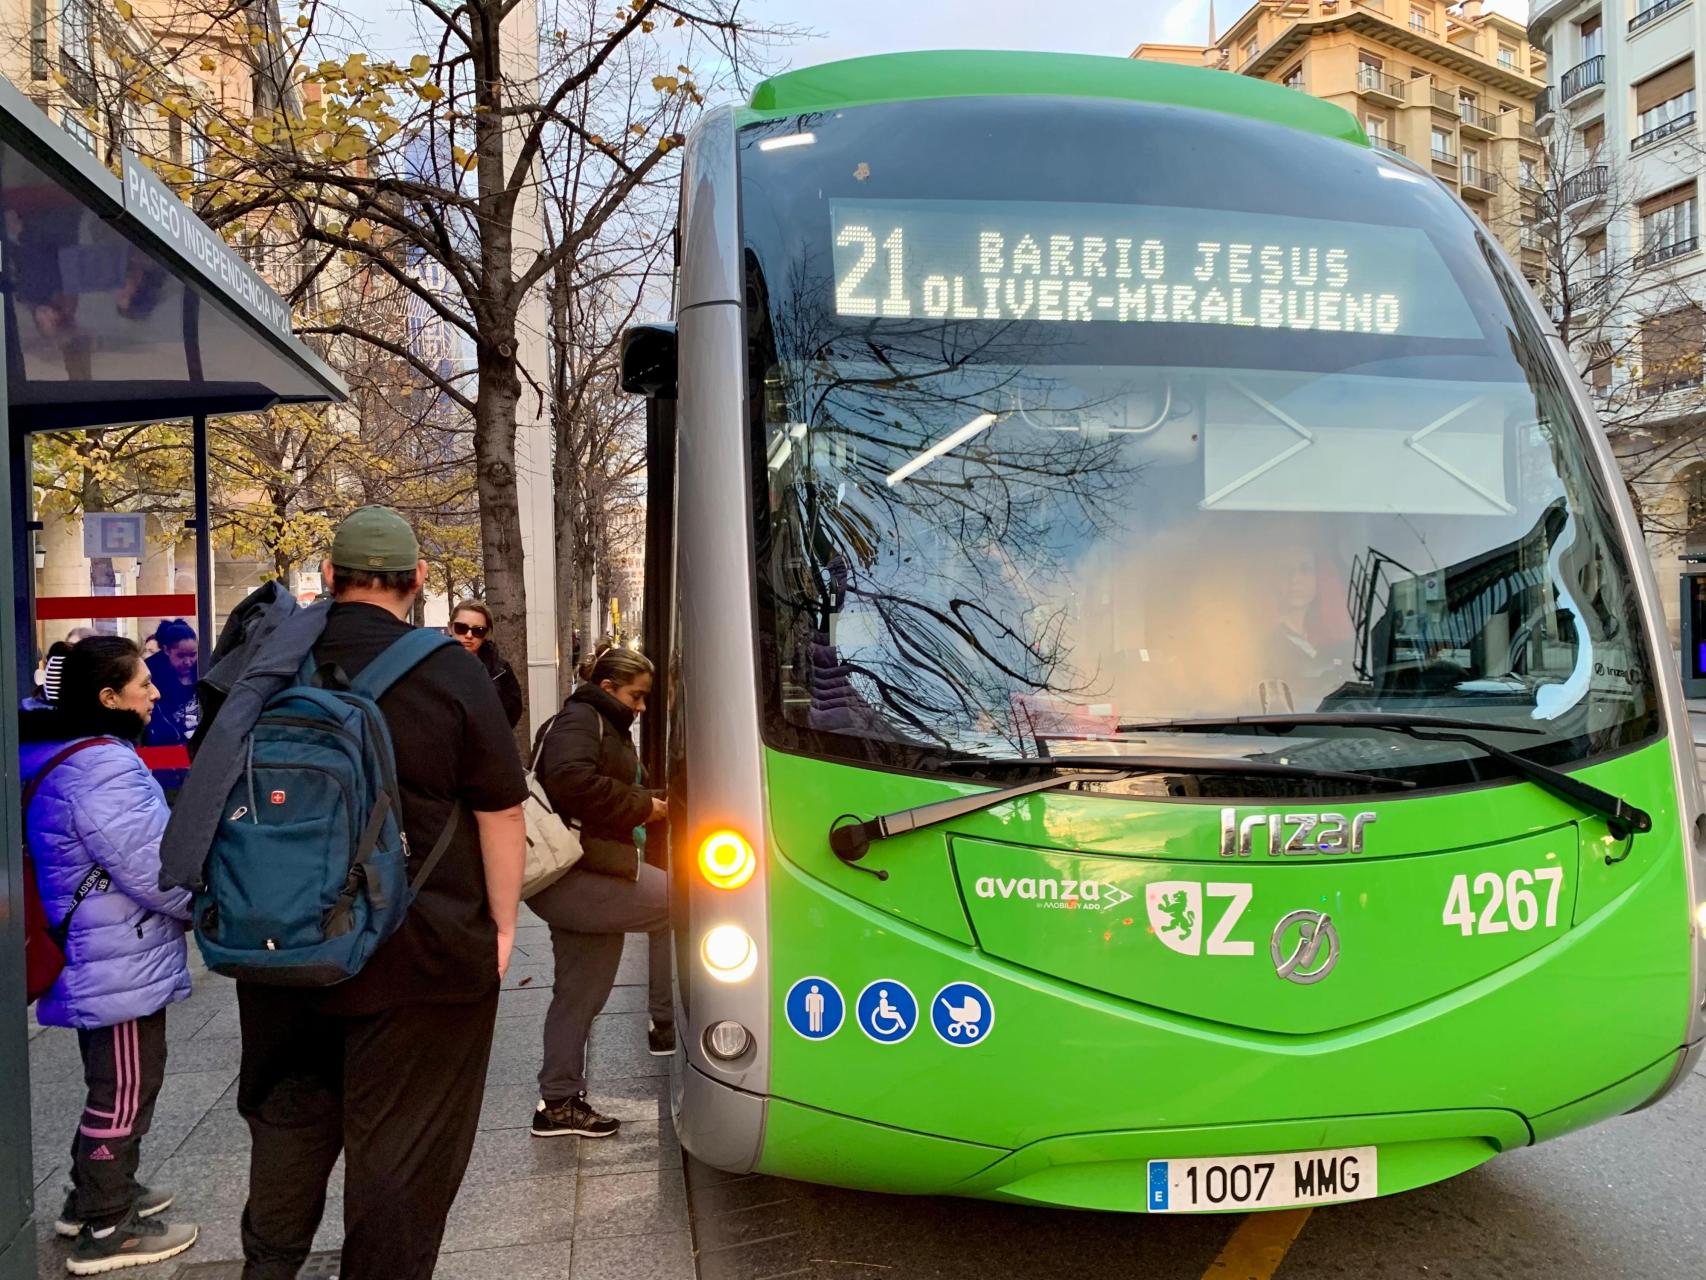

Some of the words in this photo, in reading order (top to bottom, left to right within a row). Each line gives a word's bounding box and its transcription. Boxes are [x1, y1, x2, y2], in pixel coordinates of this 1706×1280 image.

[129, 166, 180, 239] PASEO
[183, 215, 270, 316] INDEPENDENCIA
[979, 231, 1165, 281] BARRIO
[1194, 242, 1349, 287] JESUS
[836, 225, 911, 316] 21
[922, 274, 1400, 333] OLIVER-MIRALBUENO
[1220, 807, 1377, 857] Irizar
[78, 869, 101, 897] ENERGY
[975, 876, 1100, 901] avanza
[1082, 903, 1101, 911] ADO
[1442, 866, 1564, 937] 4267
[1206, 882, 1254, 956] Z
[1154, 1190, 1163, 1202] E
[1186, 1161, 1275, 1205] 1007
[1294, 1155, 1360, 1199] MMG
